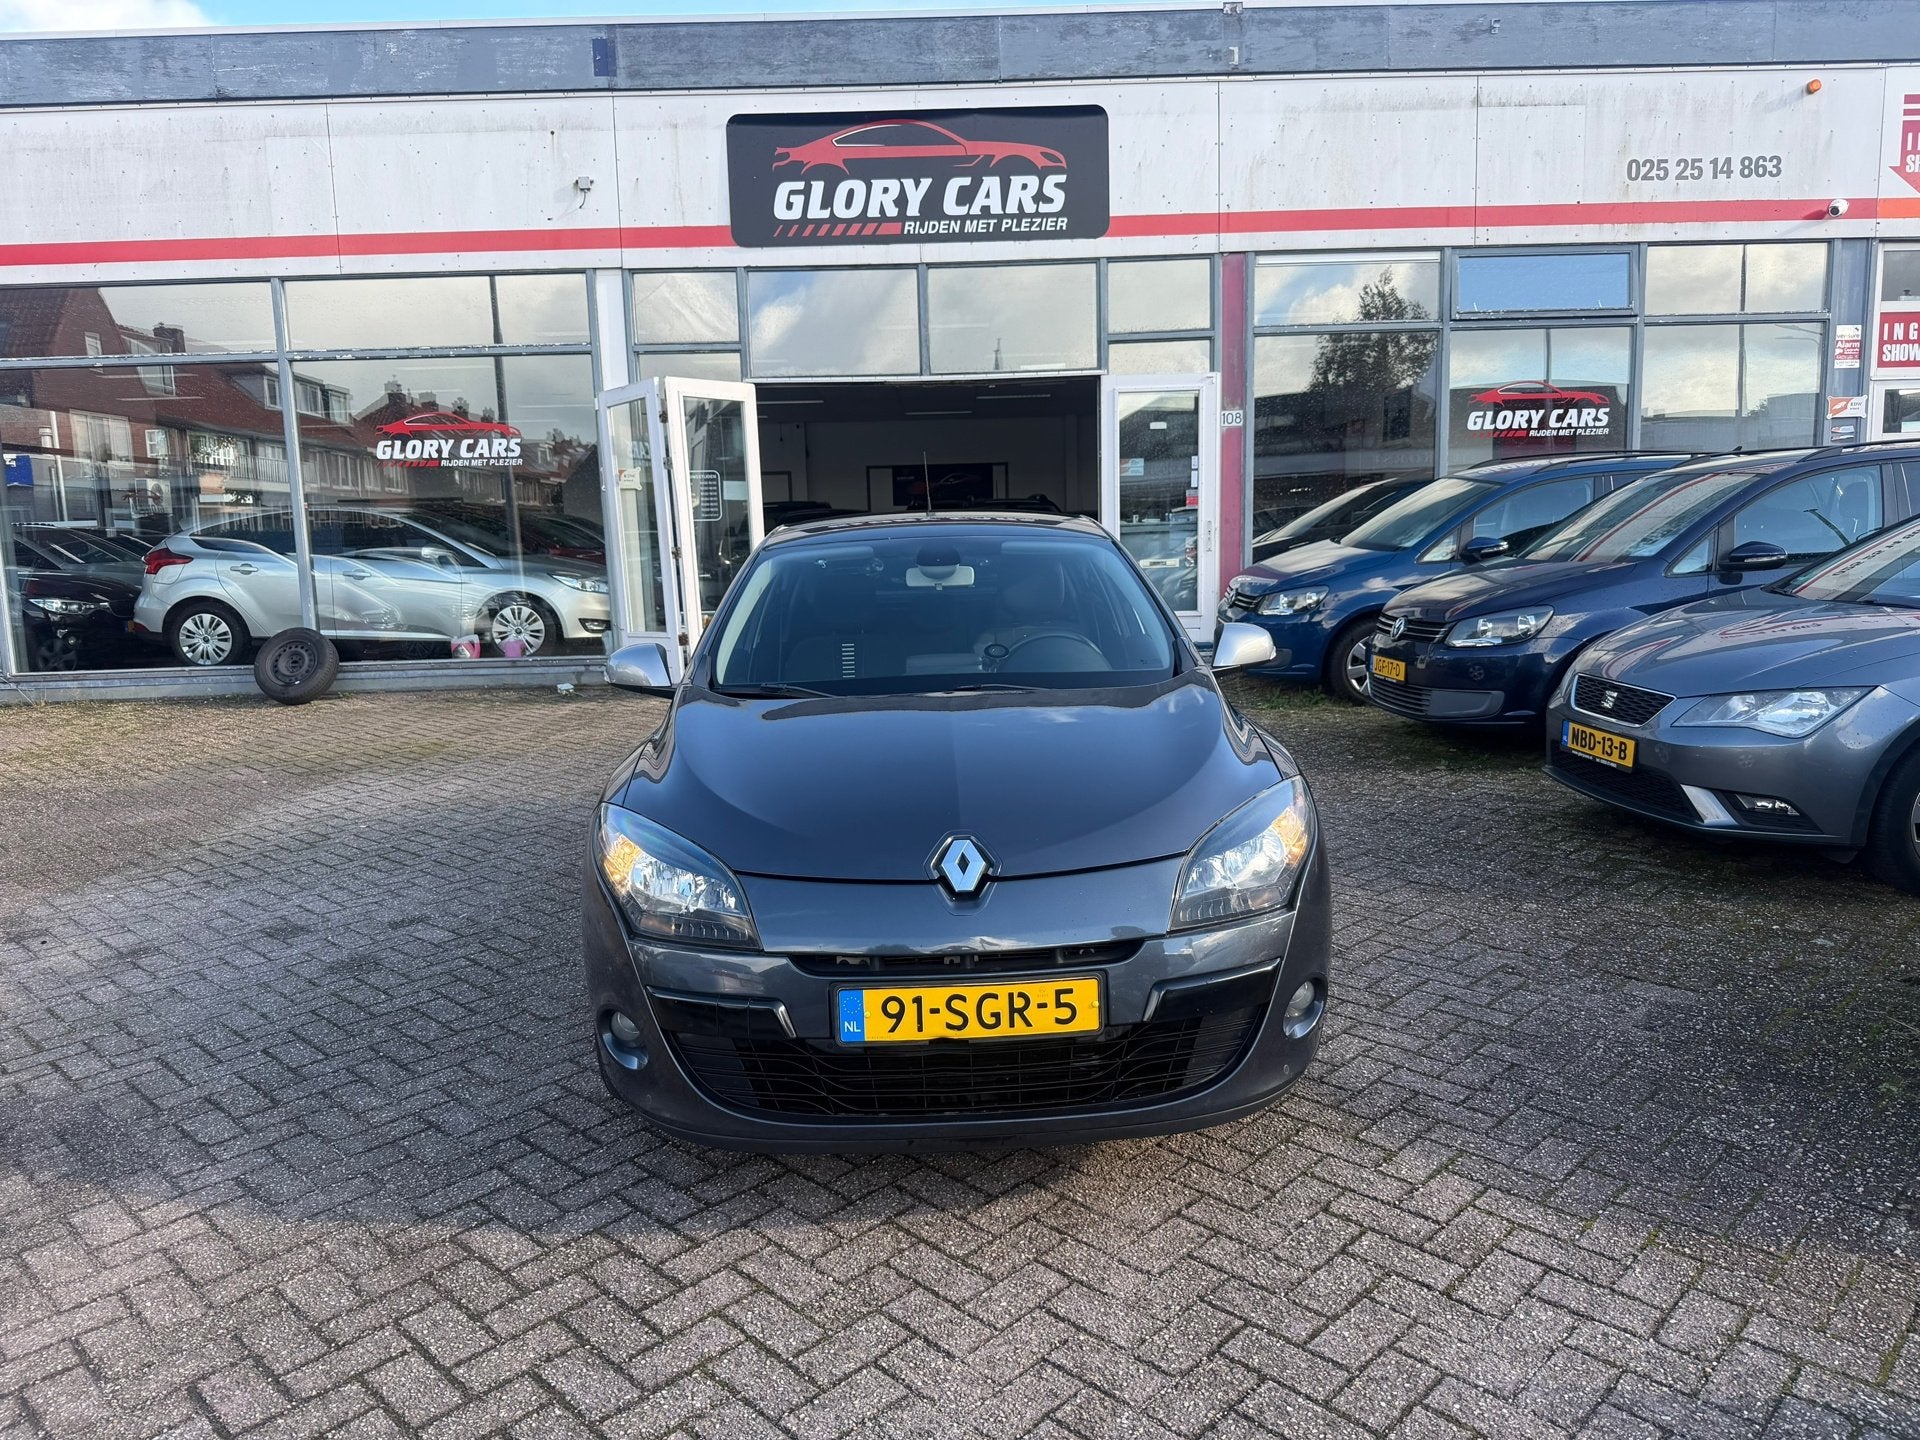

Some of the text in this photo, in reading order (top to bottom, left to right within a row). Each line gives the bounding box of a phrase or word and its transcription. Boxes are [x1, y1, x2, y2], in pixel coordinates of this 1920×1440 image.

[1627, 155, 1782, 181] 025 25 14 863
[773, 174, 1067, 220] GLORY CARS
[903, 217, 1068, 235] RIJDEN MET PLEZIER
[1836, 340, 1860, 348] Alarm
[1882, 344, 1920, 362] SHOW
[1222, 412, 1242, 425] 108
[1467, 407, 1610, 430] GLORY CARS
[1529, 429, 1558, 437] RIJDEN
[1576, 427, 1610, 435] PLEZIER
[376, 438, 521, 460] GLORY CARS
[441, 459, 470, 467] RIJDEN
[489, 458, 523, 466] PLEZIER
[1375, 657, 1401, 677] JGF-17-D
[1571, 726, 1627, 761] NBD-13-B
[881, 987, 1078, 1034] 91-SGR-5
[844, 1021, 861, 1032] NL
